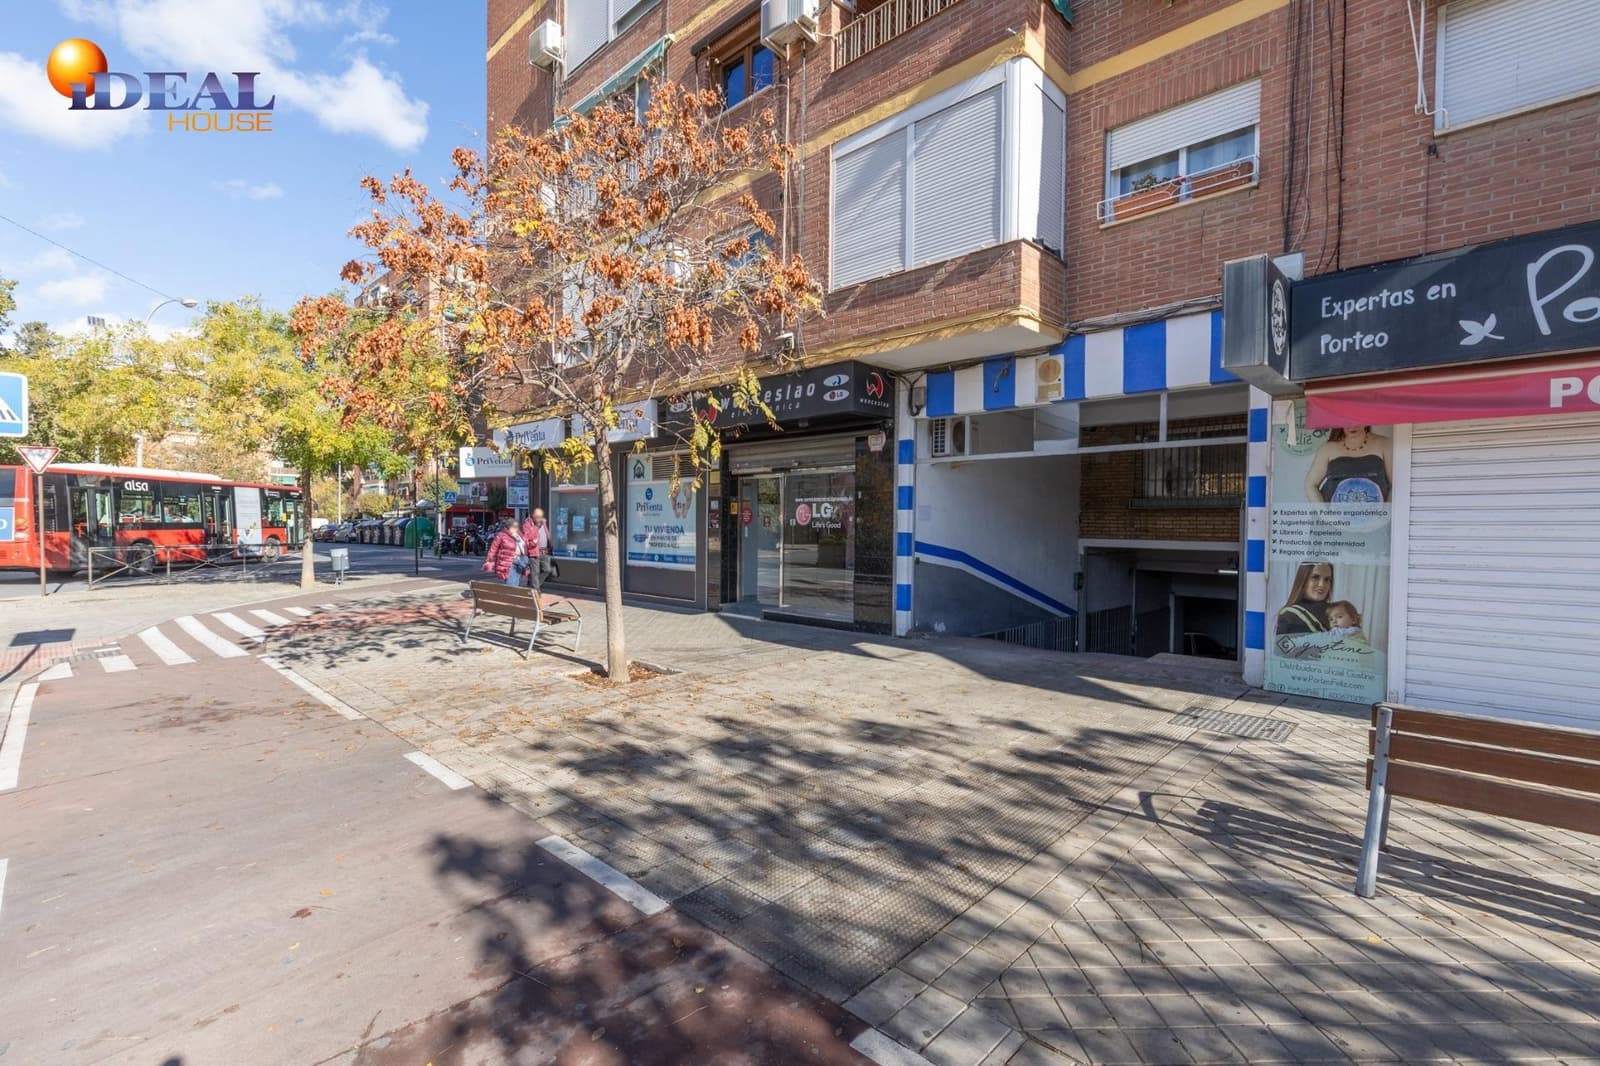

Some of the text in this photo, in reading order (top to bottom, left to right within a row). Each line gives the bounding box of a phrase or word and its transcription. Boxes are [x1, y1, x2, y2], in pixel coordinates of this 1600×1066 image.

[1321, 282, 1456, 320] Expertas en
[1320, 331, 1389, 355] Porteo
[124, 480, 149, 491] alsa
[812, 502, 833, 518] LG
